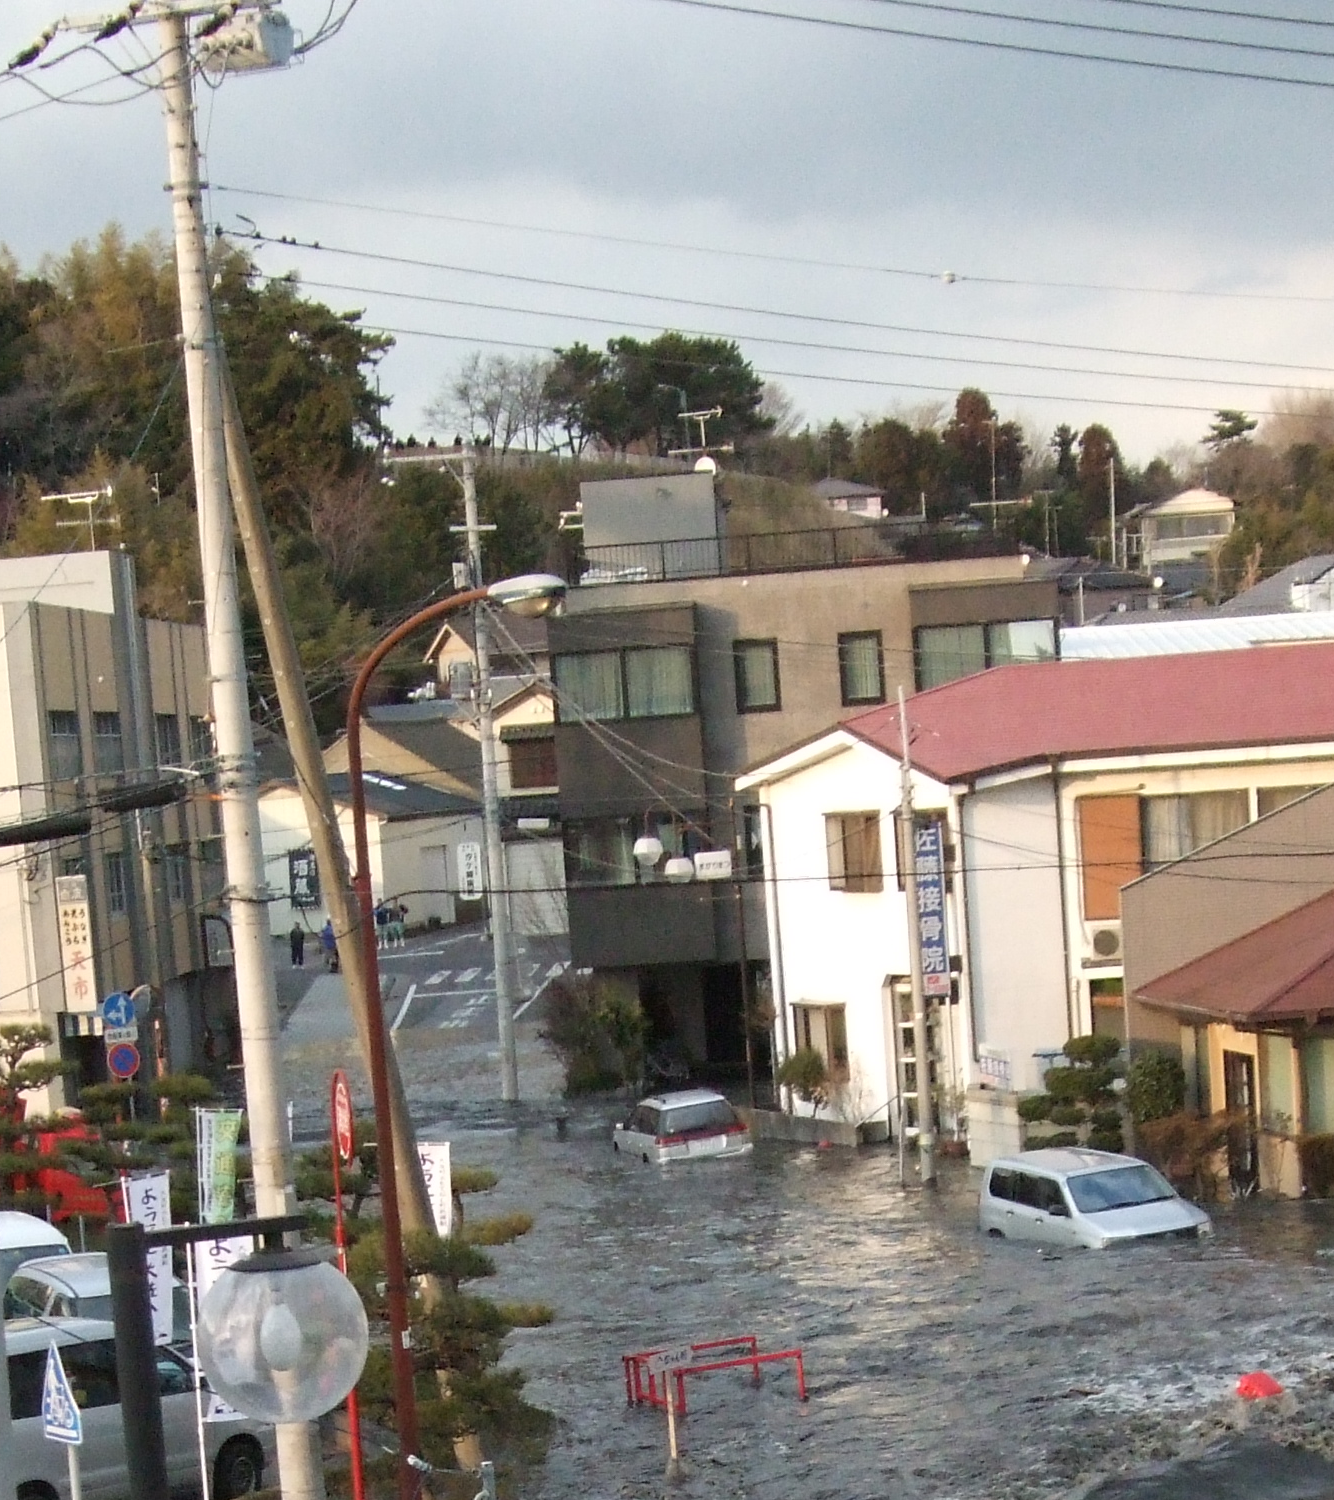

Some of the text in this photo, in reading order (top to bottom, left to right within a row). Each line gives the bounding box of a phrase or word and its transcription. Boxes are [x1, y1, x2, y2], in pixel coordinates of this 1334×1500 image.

[916, 827, 945, 973] 佐藤接骨院
